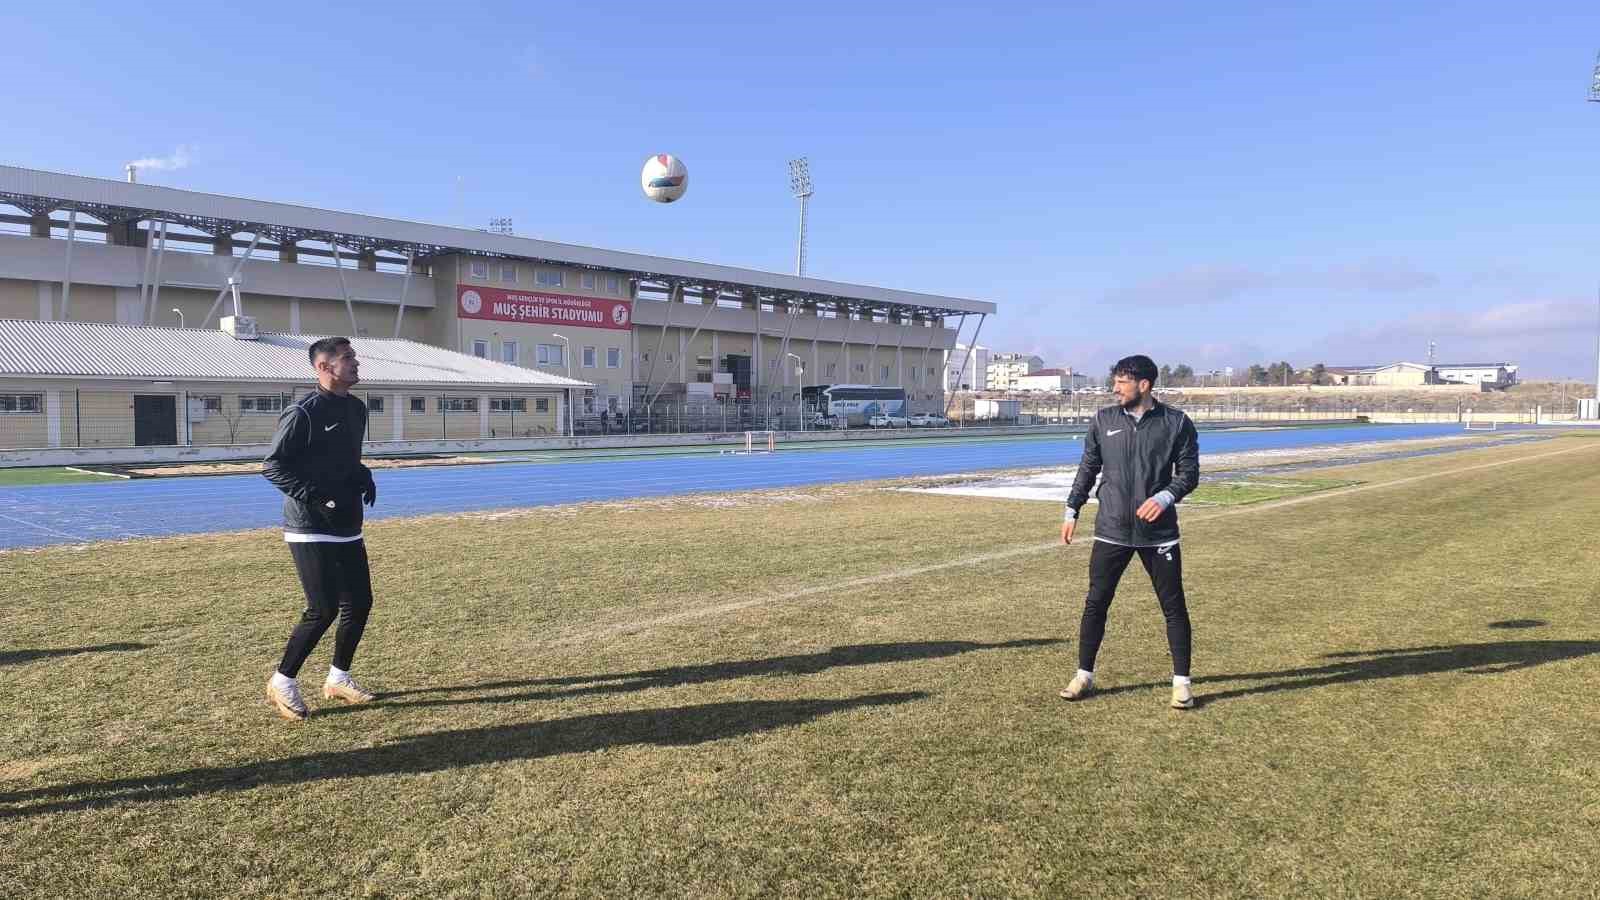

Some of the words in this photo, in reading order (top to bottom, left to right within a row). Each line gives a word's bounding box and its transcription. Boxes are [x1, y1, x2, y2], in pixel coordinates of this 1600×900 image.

[493, 303, 517, 319] MUŞ
[519, 304, 550, 320] ŞEHİR
[551, 308, 604, 323] STADYUMU
